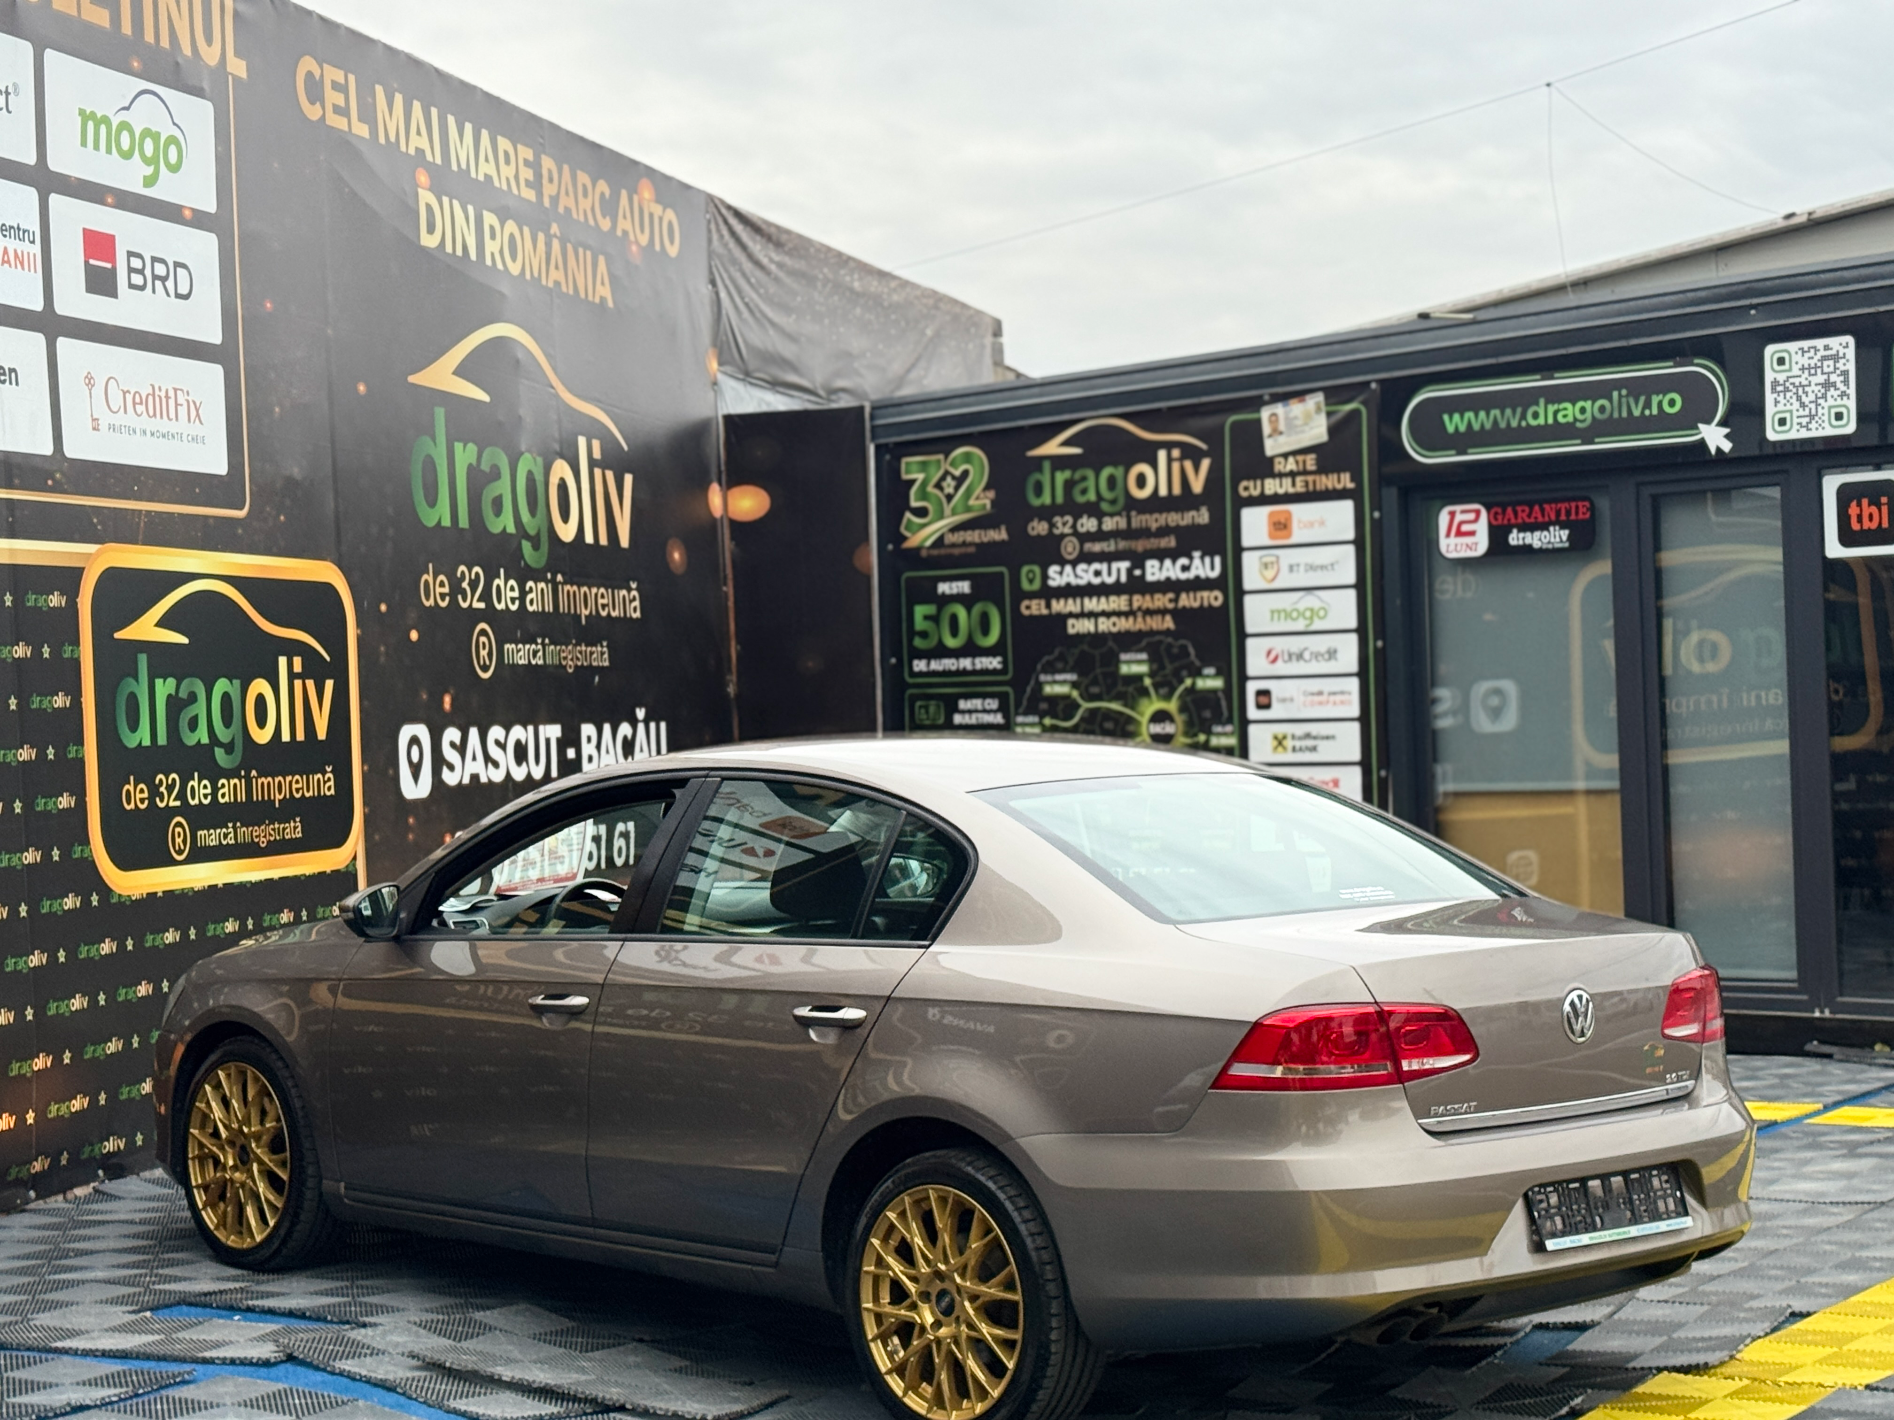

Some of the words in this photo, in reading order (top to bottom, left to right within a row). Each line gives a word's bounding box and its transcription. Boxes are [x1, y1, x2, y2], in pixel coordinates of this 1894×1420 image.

[78, 107, 184, 188] mogo
[295, 55, 370, 139] CEL
[375, 84, 442, 165] MAI
[447, 114, 536, 203] MARE
[541, 154, 612, 232] PARC
[616, 189, 681, 258] AUTO
[417, 187, 477, 261] DIN
[482, 222, 614, 309] ROMÂNIA
[126, 250, 194, 301] BRD
[104, 376, 204, 426] CreditFix
[1442, 389, 1683, 435] www.dragoliv.ro
[107, 422, 137, 436] PRIETEN
[149, 429, 184, 443] MOMENTE
[1025, 447, 1212, 514] dragoliv
[1273, 453, 1317, 474] RATE
[410, 406, 634, 569] dragoliv
[900, 446, 990, 538] 32
[1238, 479, 1262, 498] CU
[1264, 472, 1356, 496] BULETINUL
[1027, 517, 1049, 536] de
[1052, 515, 1074, 535] 32
[1076, 513, 1098, 533] de
[1101, 510, 1127, 531] ani
[1130, 505, 1210, 533] împreună
[1445, 508, 1482, 539] 12
[1489, 501, 1591, 526] GARANTIE
[1848, 496, 1890, 531] tbi
[1445, 542, 1479, 554] LUNI
[1508, 525, 1570, 549] dragoliv
[1047, 560, 1131, 588] SASCUT
[1145, 550, 1222, 582] BACĂU
[25, 590, 67, 611] dragoliv
[420, 563, 450, 608] de
[456, 565, 486, 609] 32
[492, 568, 520, 611] de
[525, 572, 553, 613] ani
[556, 573, 642, 625] împreună
[1020, 598, 1049, 616] CEL
[1051, 597, 1081, 615] MAI
[1083, 594, 1130, 613] MARE
[1132, 592, 1176, 610] PARC
[1177, 590, 1224, 609] AUTO
[912, 601, 1001, 650] 500
[1066, 617, 1095, 635] DIN
[1269, 606, 1328, 629] mogo
[504, 637, 544, 665] marcă
[30, 692, 71, 712] dragoliv
[115, 653, 334, 769] dragoliv
[442, 723, 561, 786] SASCUT
[35, 792, 76, 814] dragoliv
[121, 775, 149, 811] de
[155, 772, 181, 808] 32
[186, 771, 212, 806] de
[217, 769, 246, 804] ani
[251, 765, 335, 808] împreună
[197, 821, 235, 848] marcă
[236, 816, 302, 848] înregistrată
[613, 820, 636, 868] 61
[40, 892, 82, 915] dragoliv
[4, 949, 48, 973] dragoliv
[78, 937, 118, 960] dragoliv
[144, 927, 181, 949] dragoliv
[206, 917, 240, 938] dragoliv
[262, 908, 295, 928] dragoliv
[46, 993, 89, 1016] dragoliv
[117, 980, 154, 1002] dragoliv
[8, 1052, 53, 1077] dragoliv
[83, 1036, 124, 1059] dragoliv
[47, 1093, 90, 1118] dragoliv
[1429, 1101, 1478, 1117] PASSAT
